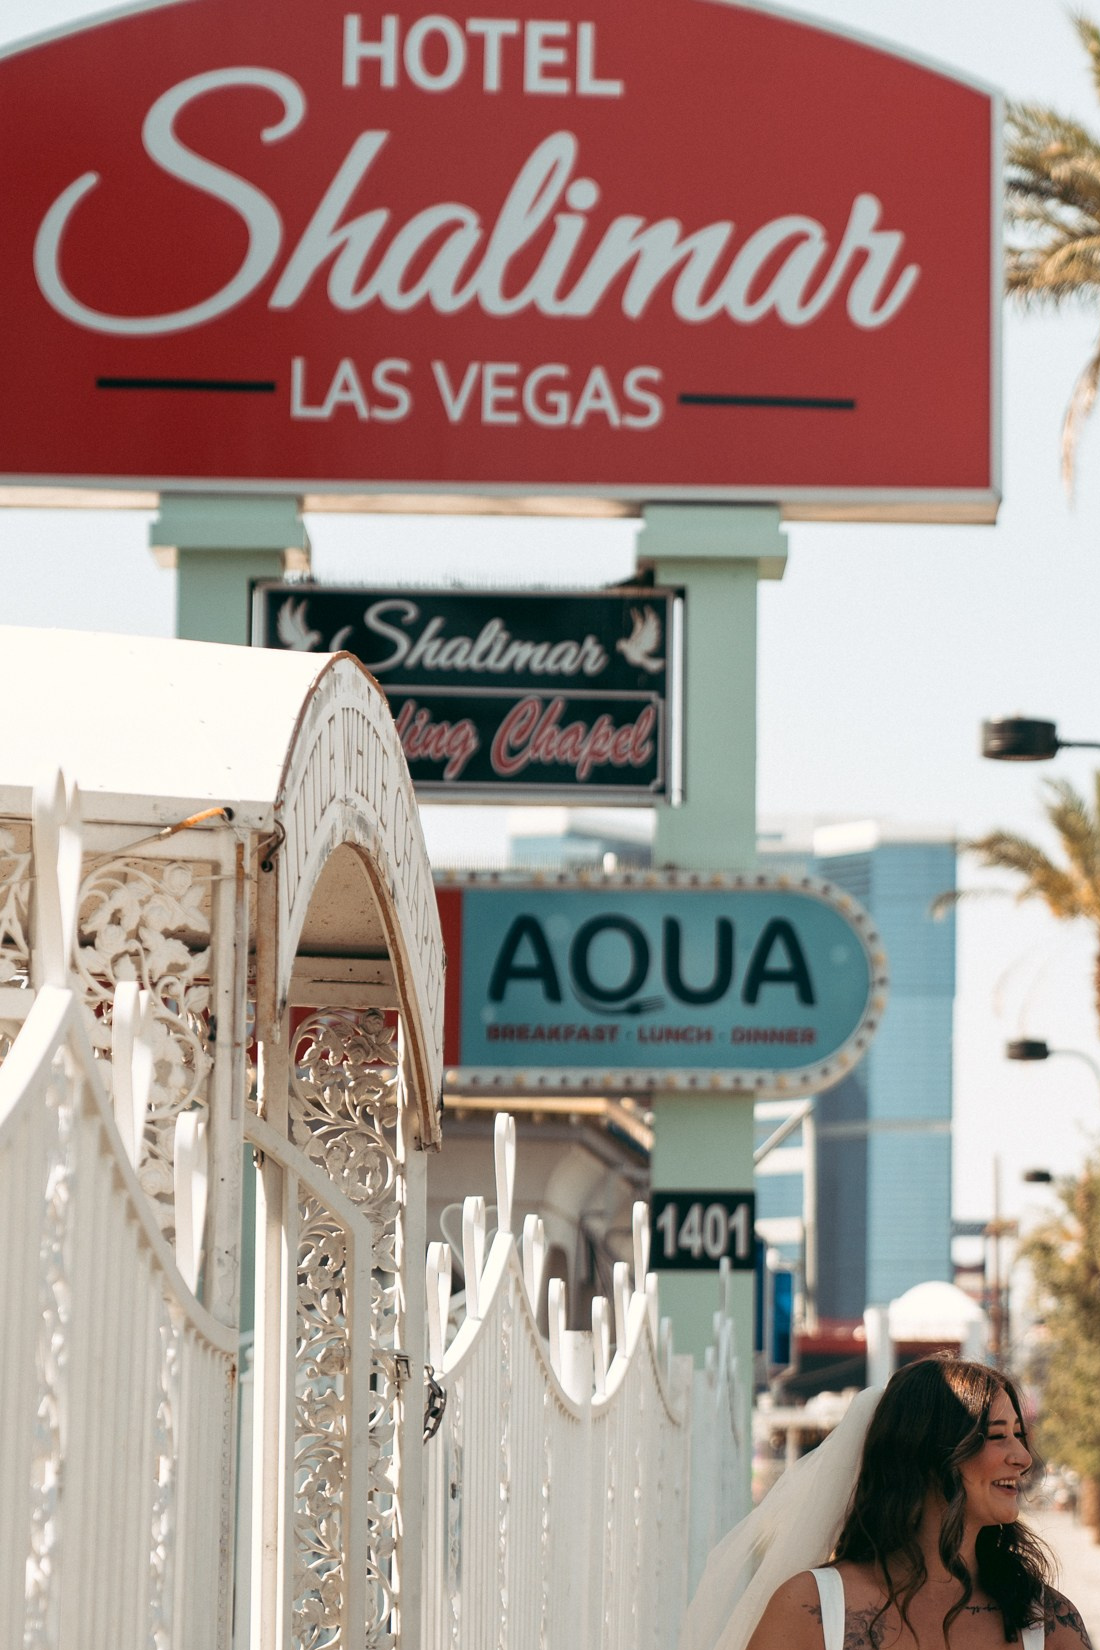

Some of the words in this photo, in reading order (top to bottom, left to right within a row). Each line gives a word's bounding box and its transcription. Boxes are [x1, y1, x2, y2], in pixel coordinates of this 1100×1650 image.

[342, 14, 624, 97] HOTEL
[33, 66, 921, 336] Shalimar
[290, 356, 412, 422] LAS
[431, 360, 664, 430] VEGAS
[330, 600, 607, 676] Shalimar
[341, 706, 390, 833] WHITE
[489, 694, 657, 783] Chapel
[486, 911, 818, 1012] AQUA
[485, 1023, 620, 1045] BREAKFAST
[636, 1025, 714, 1045] LUNCH
[730, 1026, 818, 1047] DINNER
[656, 1202, 749, 1261] 1401
